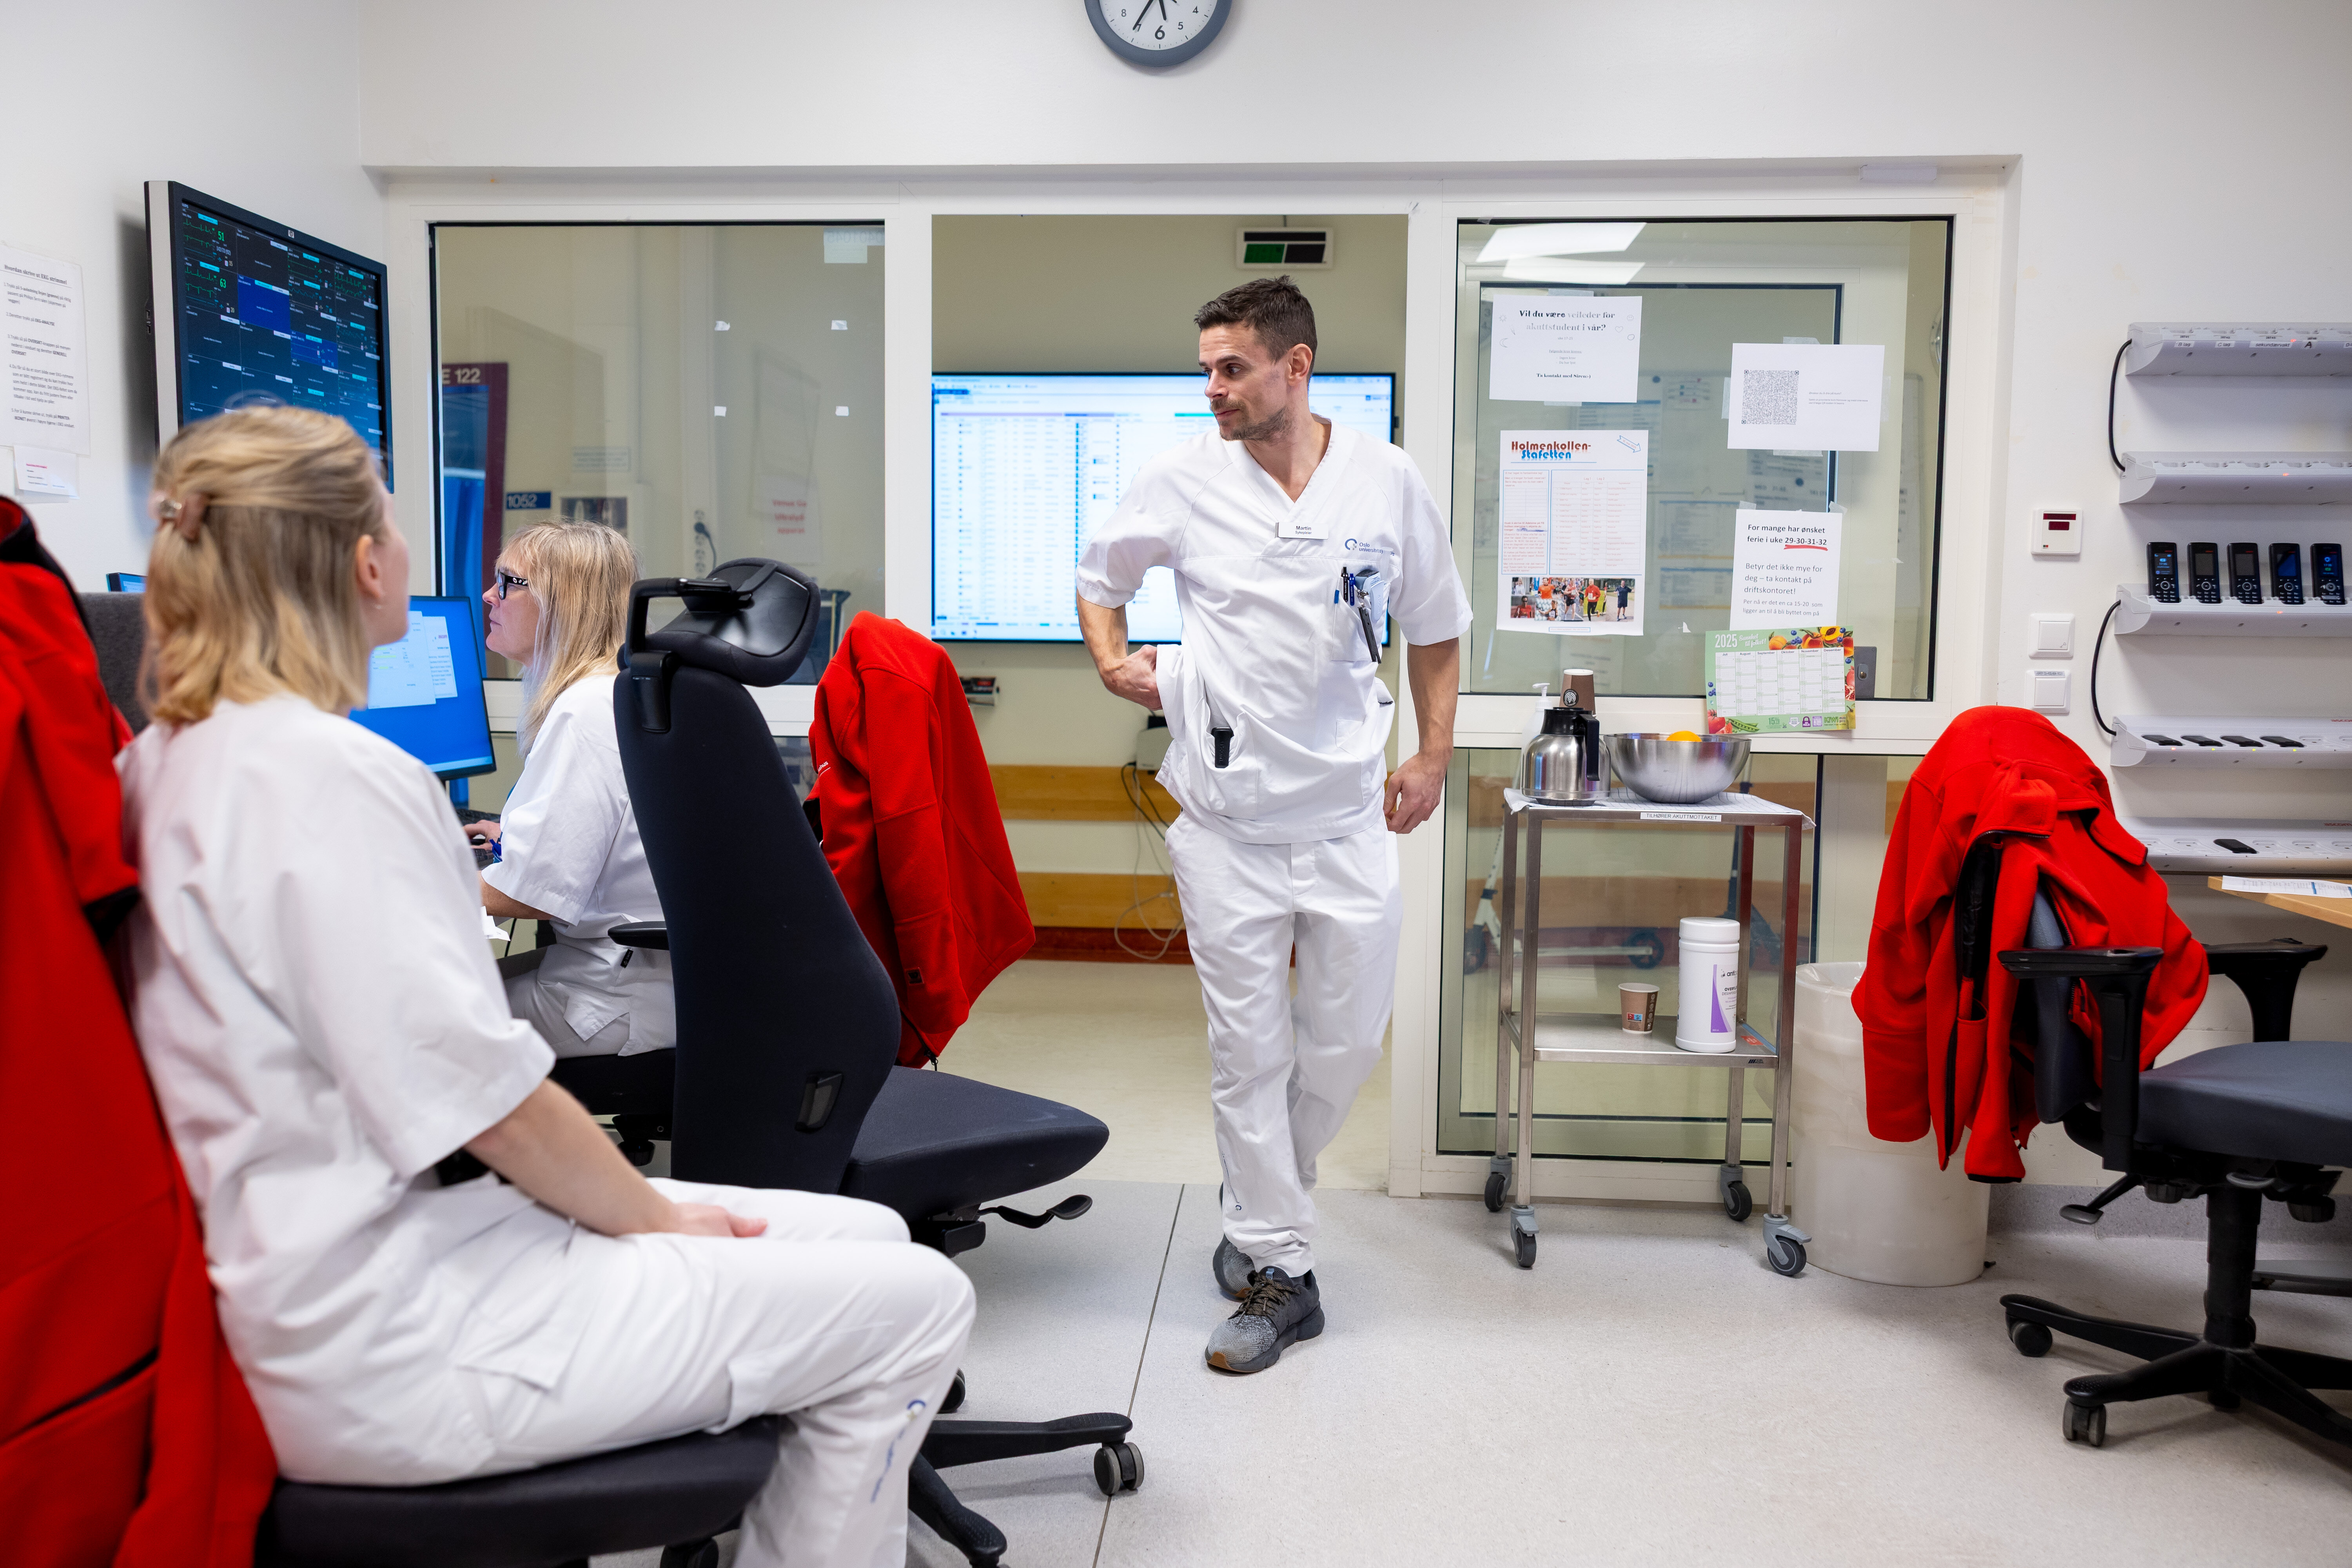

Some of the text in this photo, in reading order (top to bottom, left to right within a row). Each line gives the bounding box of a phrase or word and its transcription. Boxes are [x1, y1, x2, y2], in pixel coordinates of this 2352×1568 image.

[1122, 9, 1126, 17] 8
[1155, 25, 1165, 40] 6
[218, 231, 224, 241] 51
[5, 265, 22, 273] Hvordan
[220, 278, 226, 288] 63
[455, 368, 481, 384] 122
[1512, 441, 1591, 450] Holmenkollen-
[1522, 450, 1571, 459] Stafetten
[1359, 547, 1395, 556] universitetssyus
[1715, 634, 1738, 648] 2025
[1751, 638, 1766, 648] folket!
